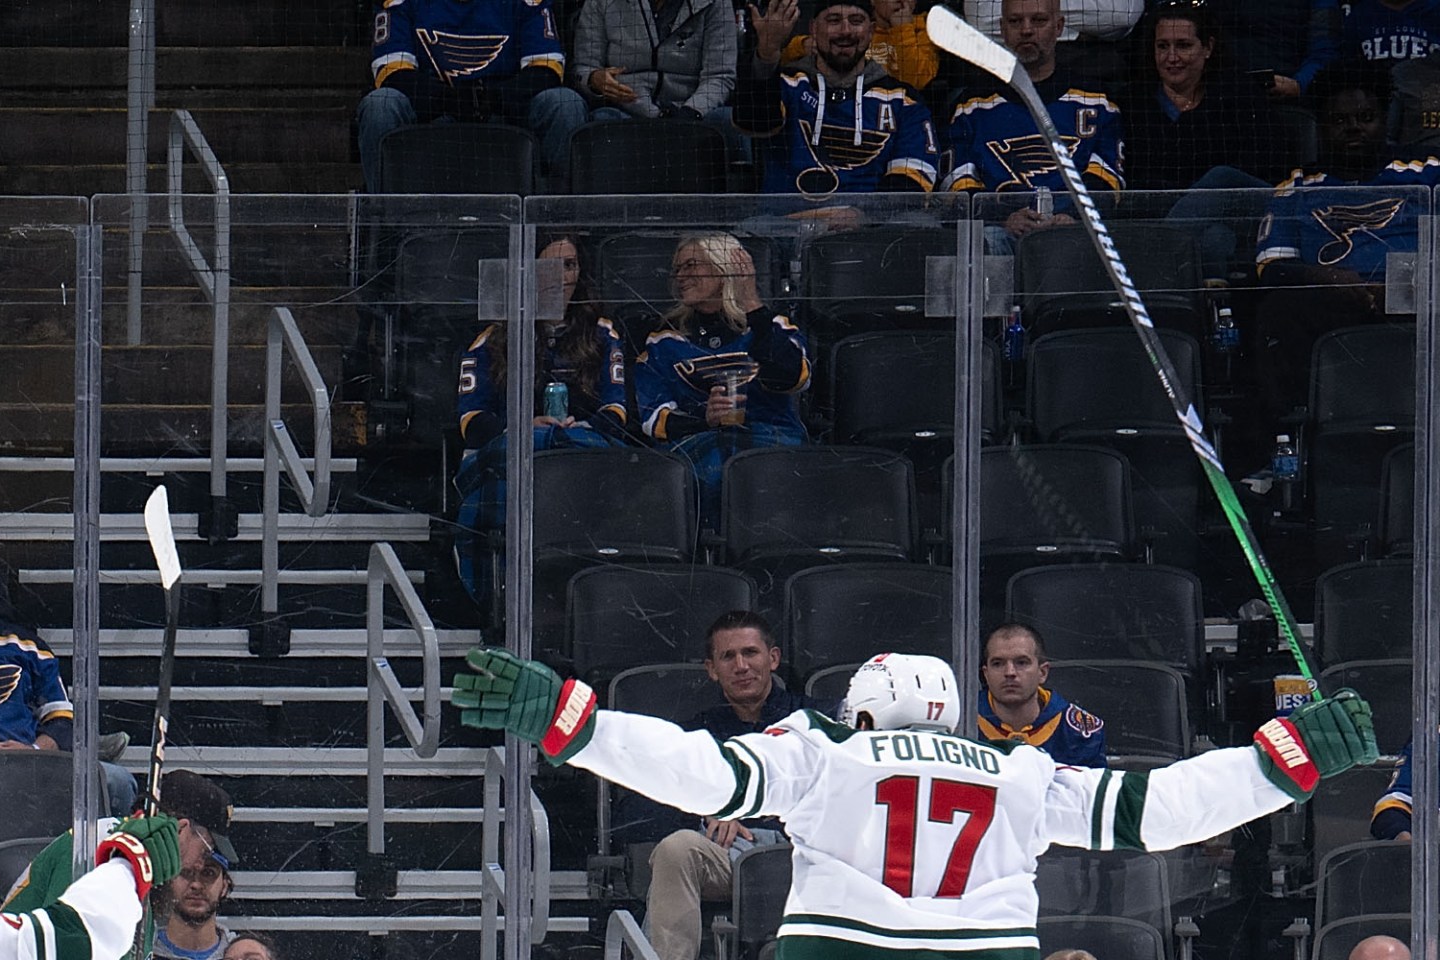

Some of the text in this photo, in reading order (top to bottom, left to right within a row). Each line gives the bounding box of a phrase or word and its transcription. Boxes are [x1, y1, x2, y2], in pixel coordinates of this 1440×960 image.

[927, 702, 945, 721] 17
[870, 734, 1001, 775] FOLIGNO
[875, 774, 998, 899] 17
